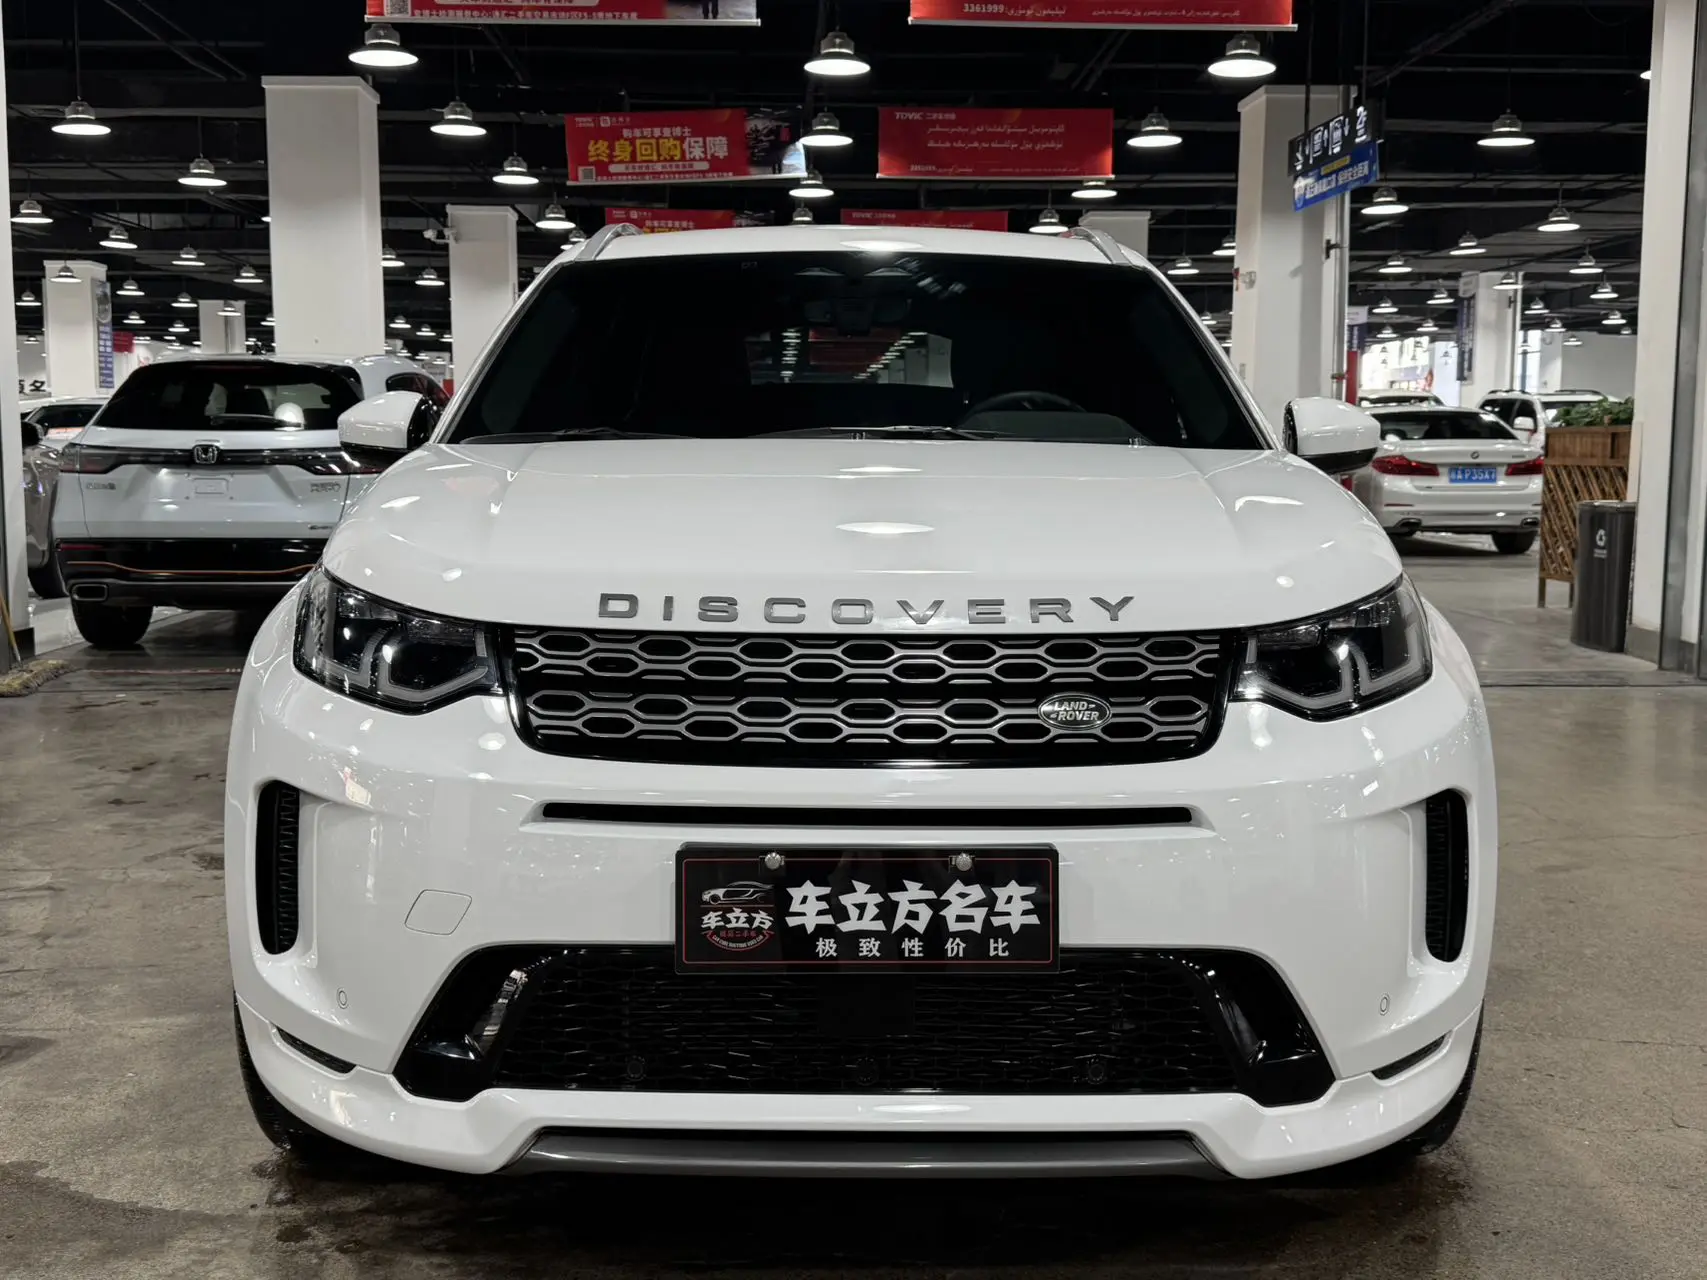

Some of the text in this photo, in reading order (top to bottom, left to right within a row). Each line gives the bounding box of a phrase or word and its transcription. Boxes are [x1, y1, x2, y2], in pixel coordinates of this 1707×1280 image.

[963, 3, 1004, 13] 3361999
[587, 136, 729, 163] 终身回购保障
[598, 592, 1135, 625] DISCOVERY
[1054, 701, 1088, 711] LAND
[1057, 711, 1100, 721] ROVER
[785, 879, 1041, 935] 车立方名车
[700, 907, 775, 930] 车立方
[815, 937, 1009, 958] 极致性价比
